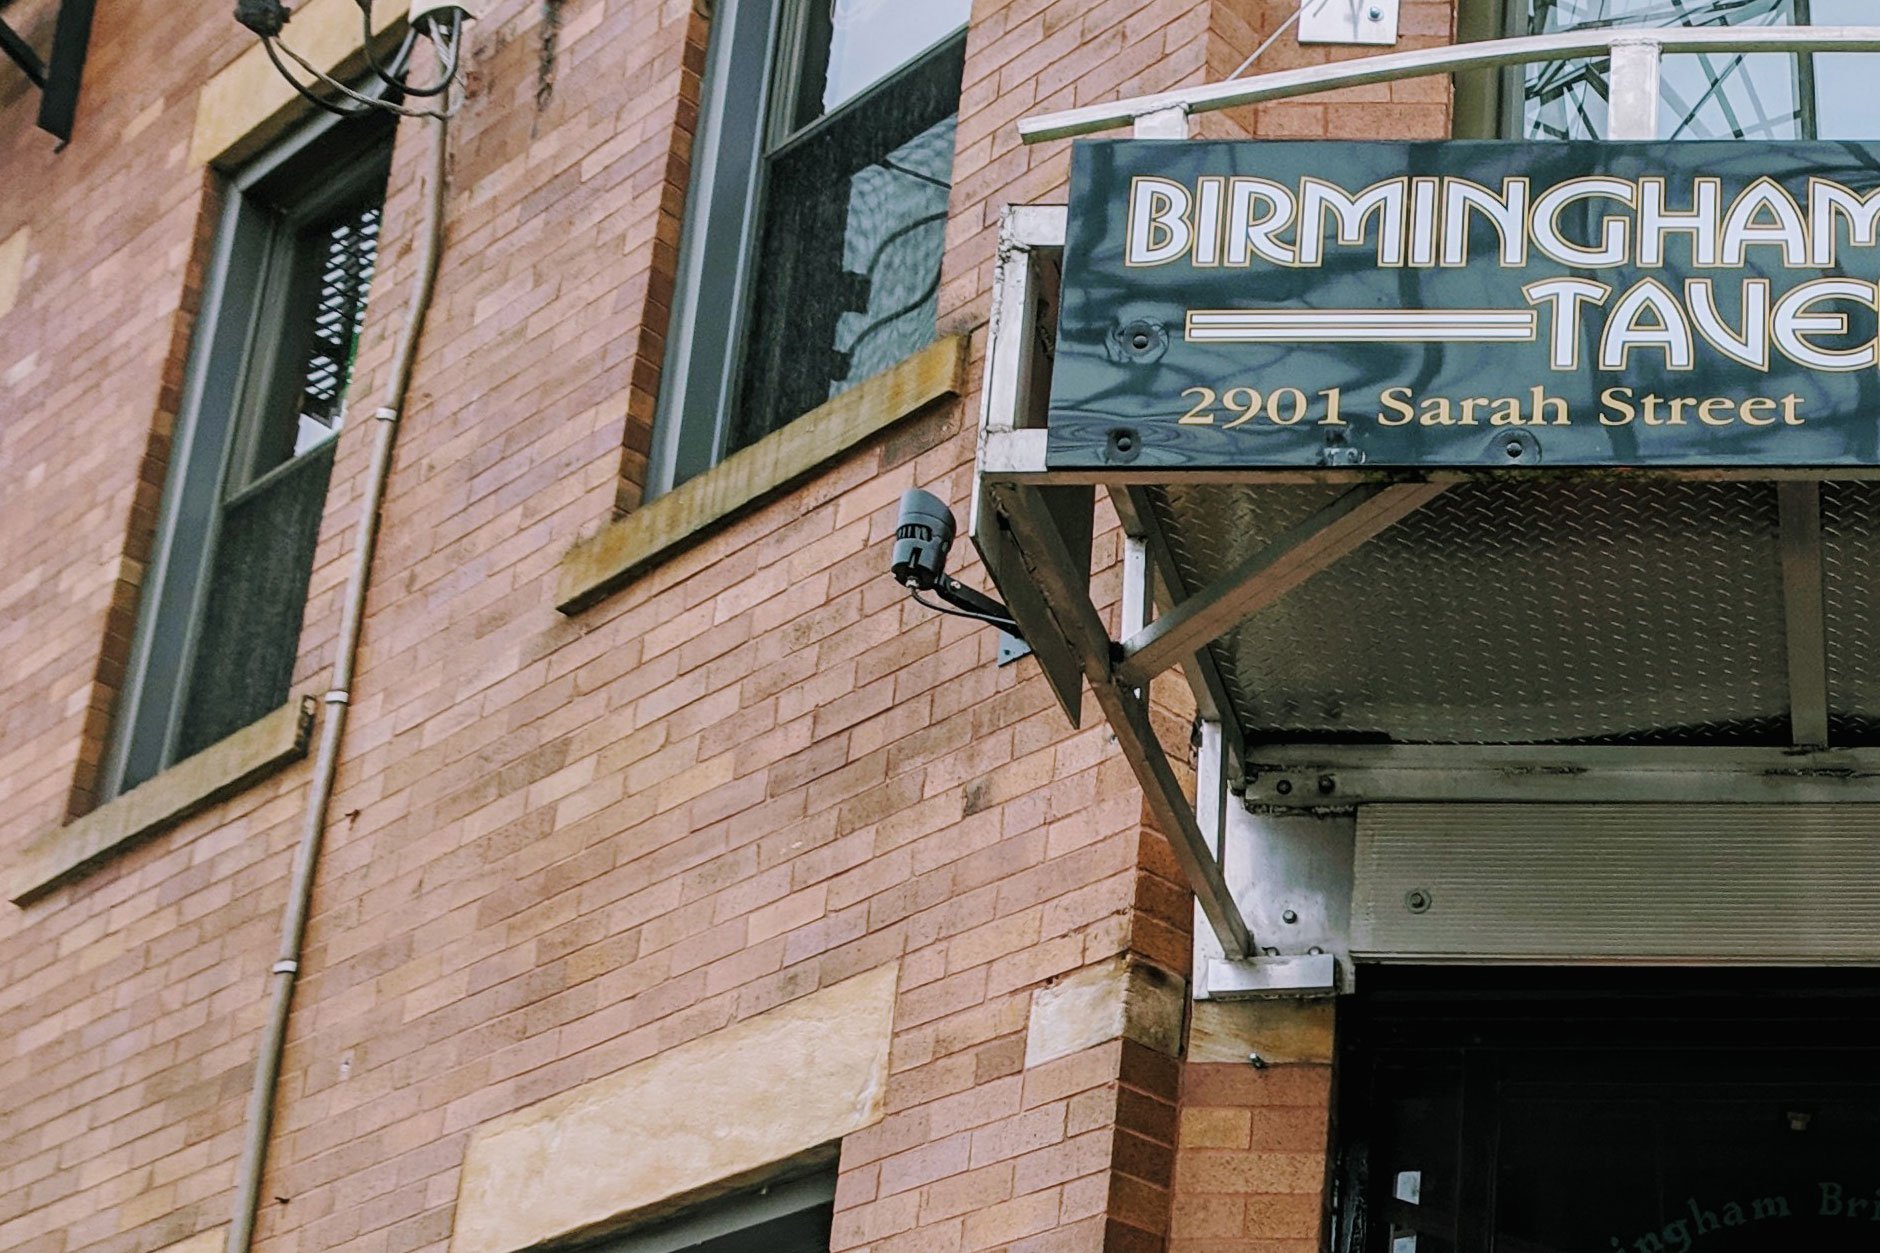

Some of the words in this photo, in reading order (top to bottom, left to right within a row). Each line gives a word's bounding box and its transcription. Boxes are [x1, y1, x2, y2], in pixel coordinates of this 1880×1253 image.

[1176, 384, 1343, 430] 2901
[1377, 384, 1571, 428] Sarah
[1600, 384, 1805, 428] Street
